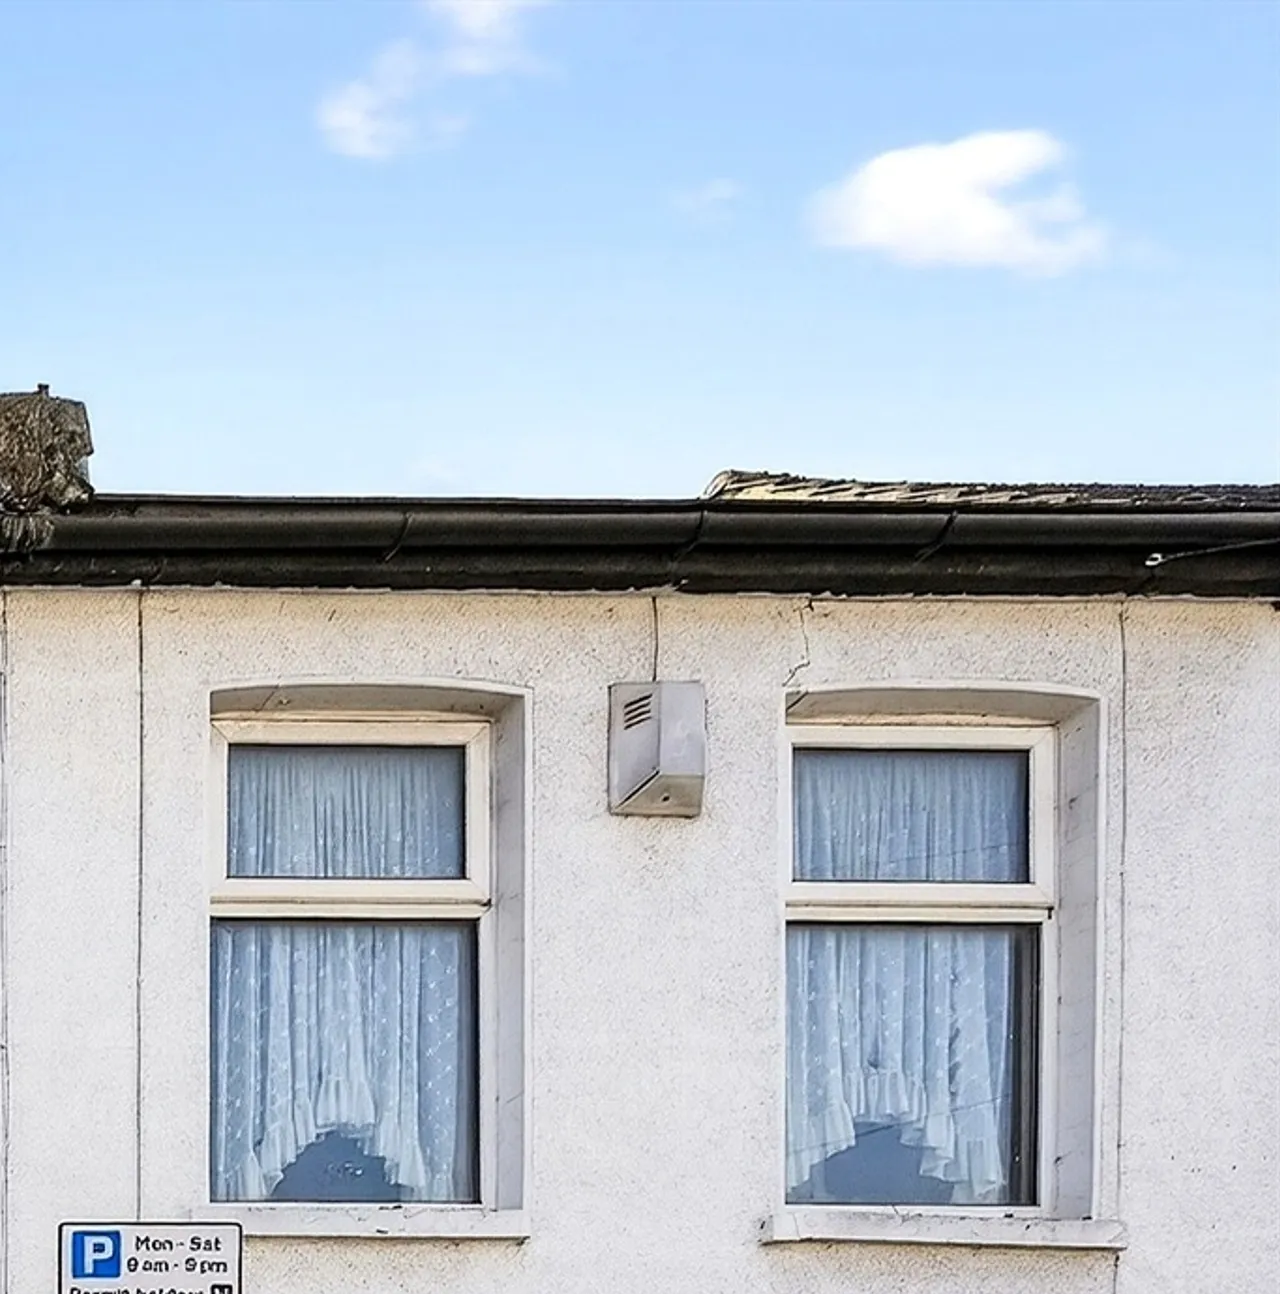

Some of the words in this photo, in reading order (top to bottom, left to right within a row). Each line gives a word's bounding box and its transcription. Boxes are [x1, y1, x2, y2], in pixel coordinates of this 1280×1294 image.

[84, 1235, 114, 1275] P
[135, 1236, 173, 1251] Mon
[190, 1236, 220, 1251] Sat
